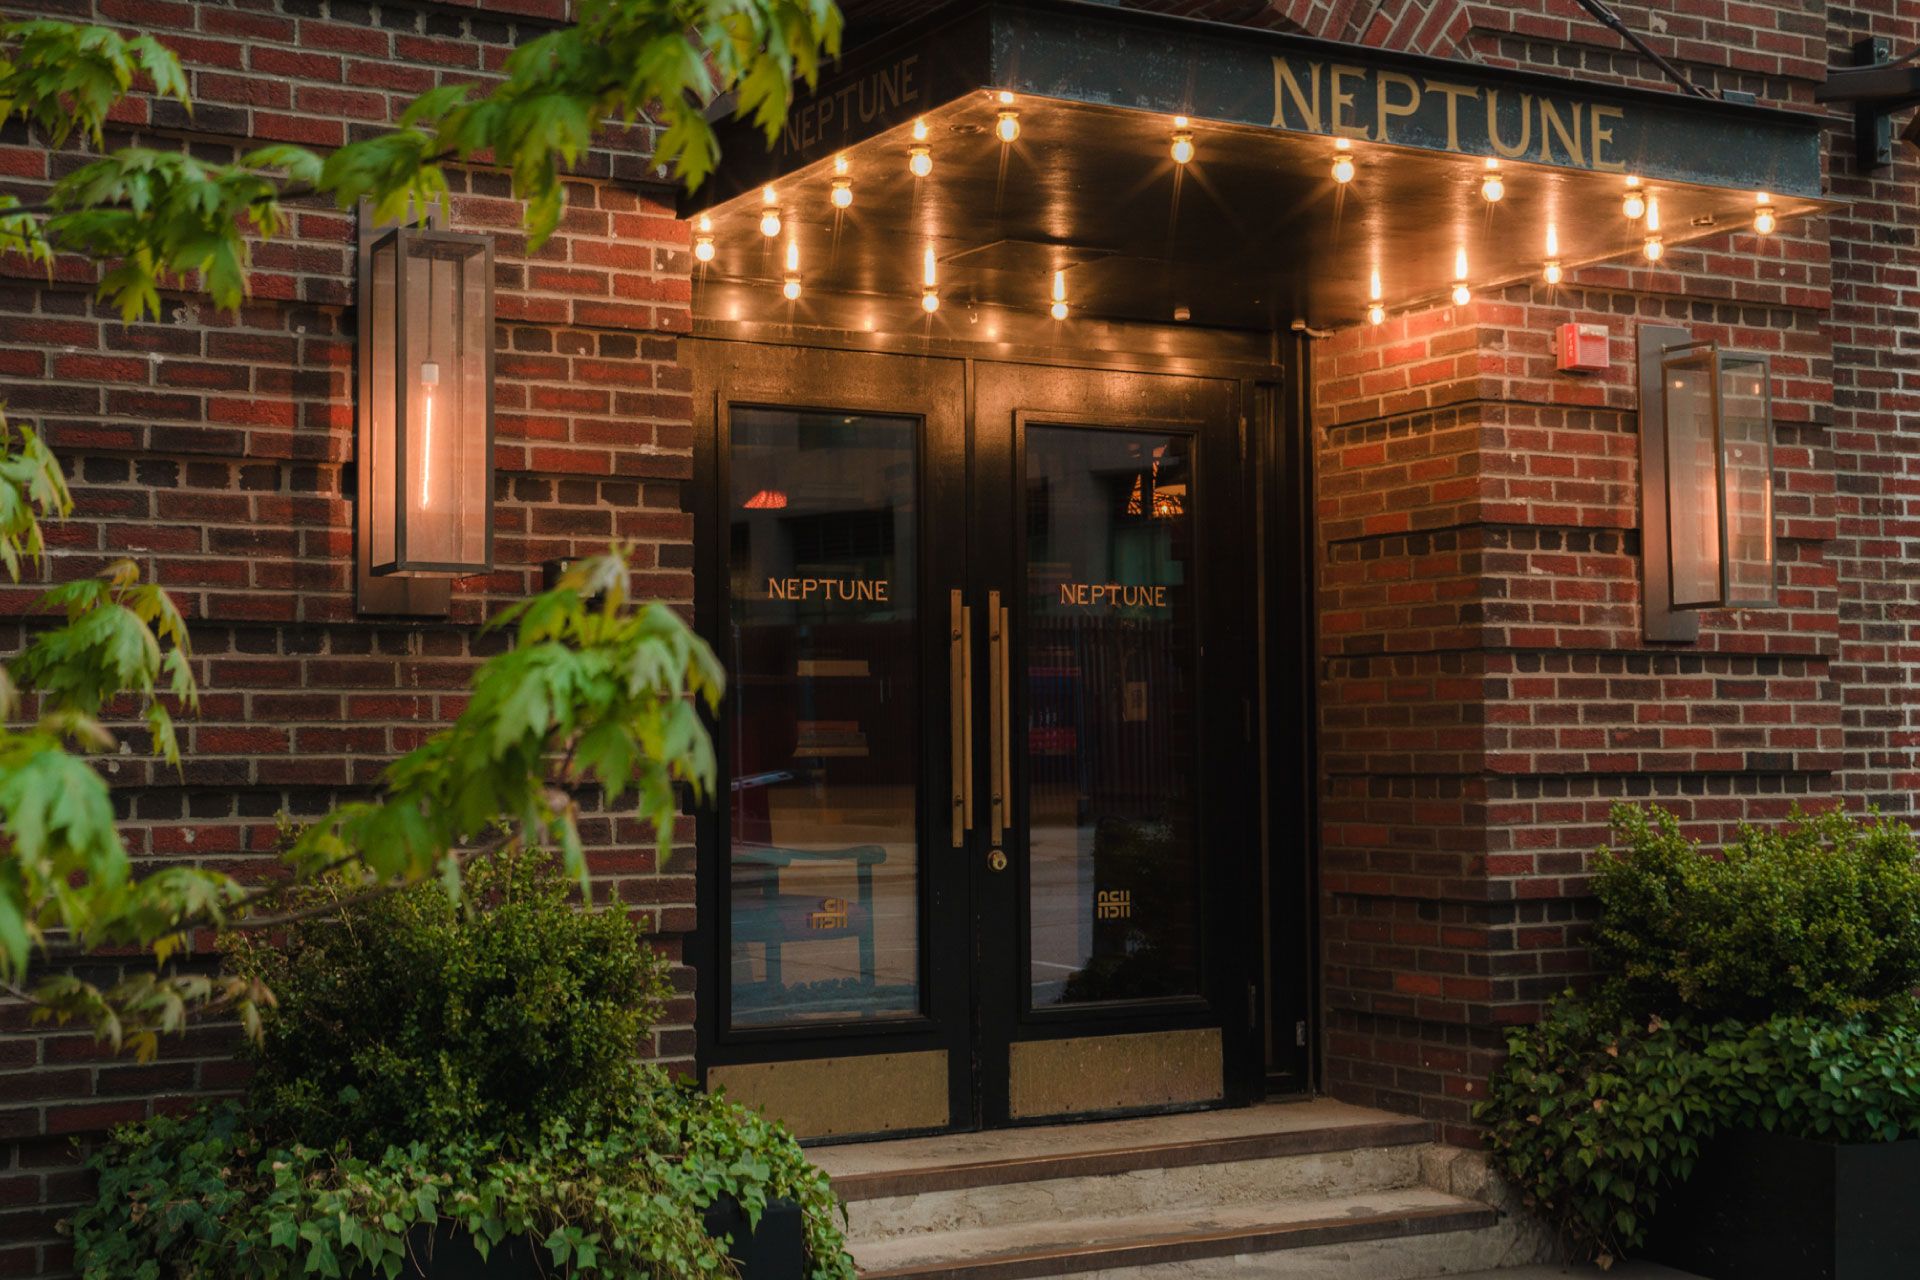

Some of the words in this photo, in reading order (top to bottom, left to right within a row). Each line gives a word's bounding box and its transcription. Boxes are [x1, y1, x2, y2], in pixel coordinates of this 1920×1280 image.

[783, 54, 919, 155] NEPTUNE
[1270, 56, 1627, 172] NEPTUNE
[768, 577, 888, 601] NEPTUNE
[1060, 583, 1166, 607] NEPTUNE
